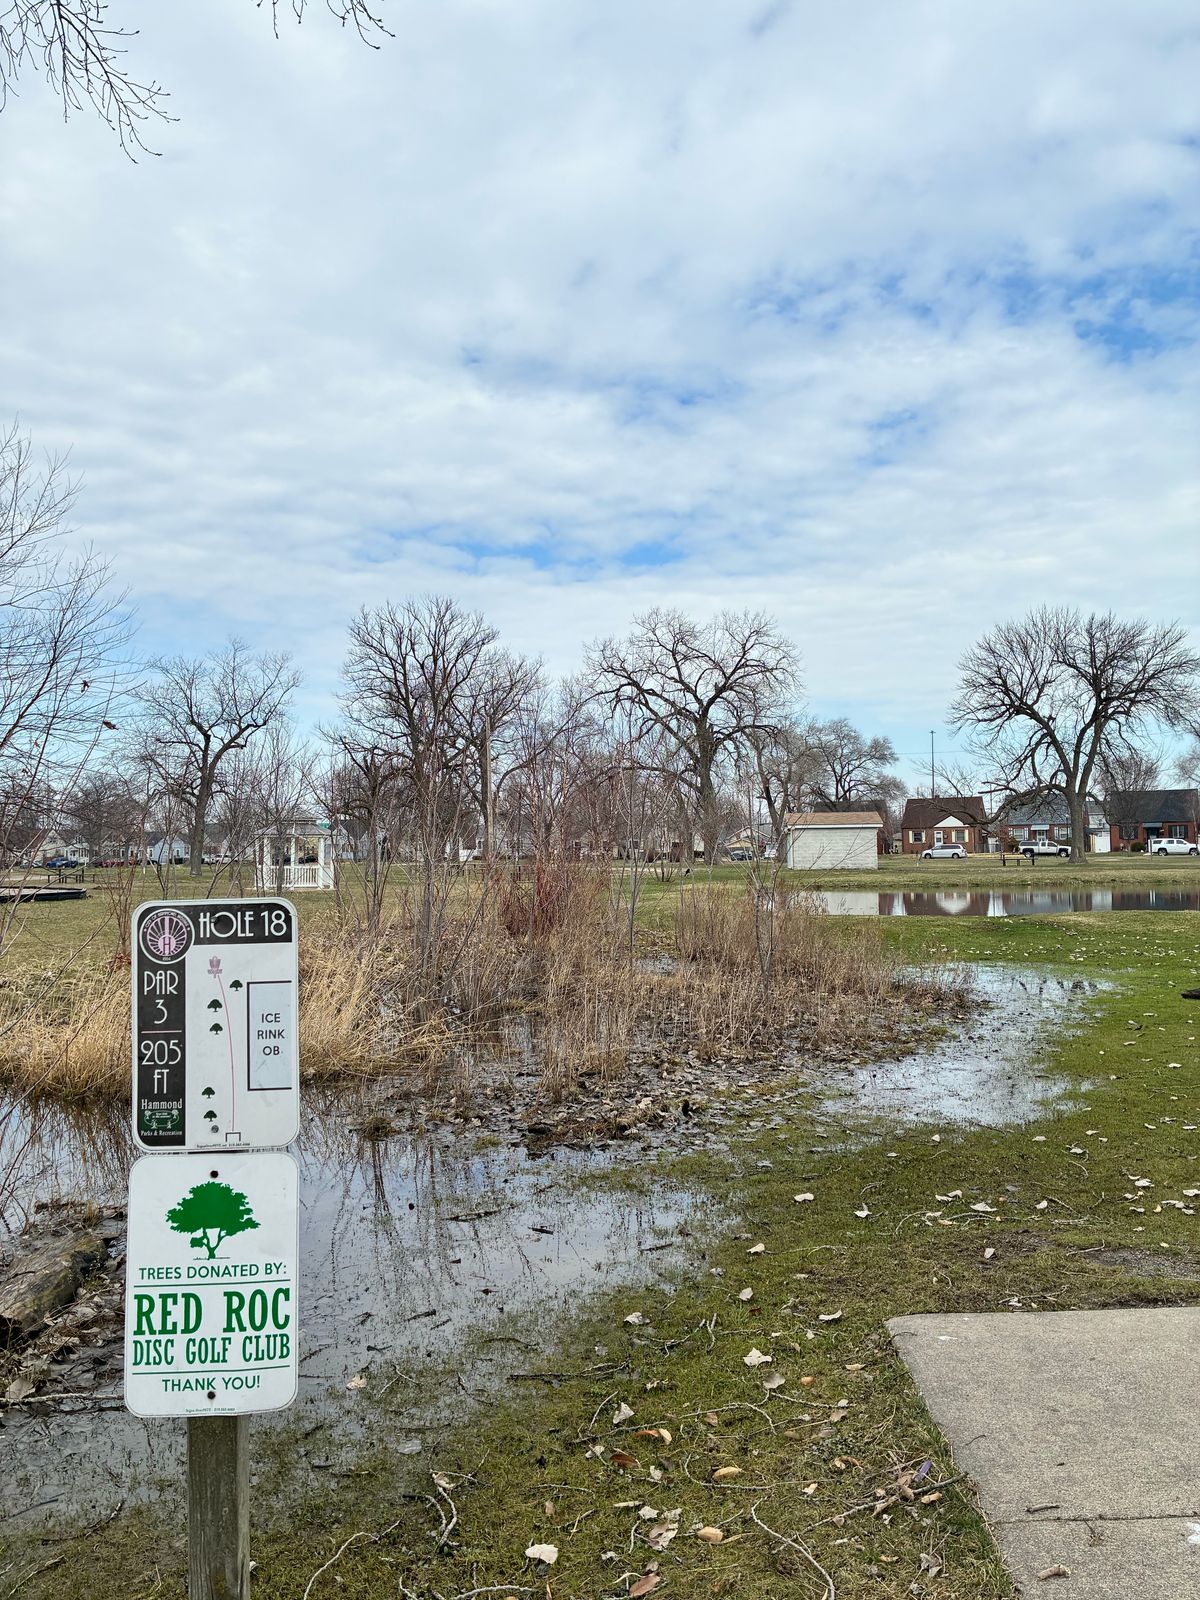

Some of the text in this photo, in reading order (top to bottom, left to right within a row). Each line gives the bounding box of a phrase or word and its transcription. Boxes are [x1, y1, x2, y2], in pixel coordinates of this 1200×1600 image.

[199, 911, 254, 938] HOLE
[260, 911, 287, 936] 18
[143, 970, 178, 995] PAR
[154, 999, 168, 1024] 3
[261, 1013, 281, 1023] ICE
[257, 1029, 285, 1040] RINK
[140, 1040, 182, 1065] 205
[262, 1046, 280, 1056] OB
[141, 1098, 183, 1110] Hammond
[139, 1262, 287, 1280] TREES DONATED BY:
[133, 1287, 290, 1335] RED ROC
[132, 1333, 290, 1366] DISC GOLF CLUB
[162, 1375, 260, 1392] THANK YOU!
